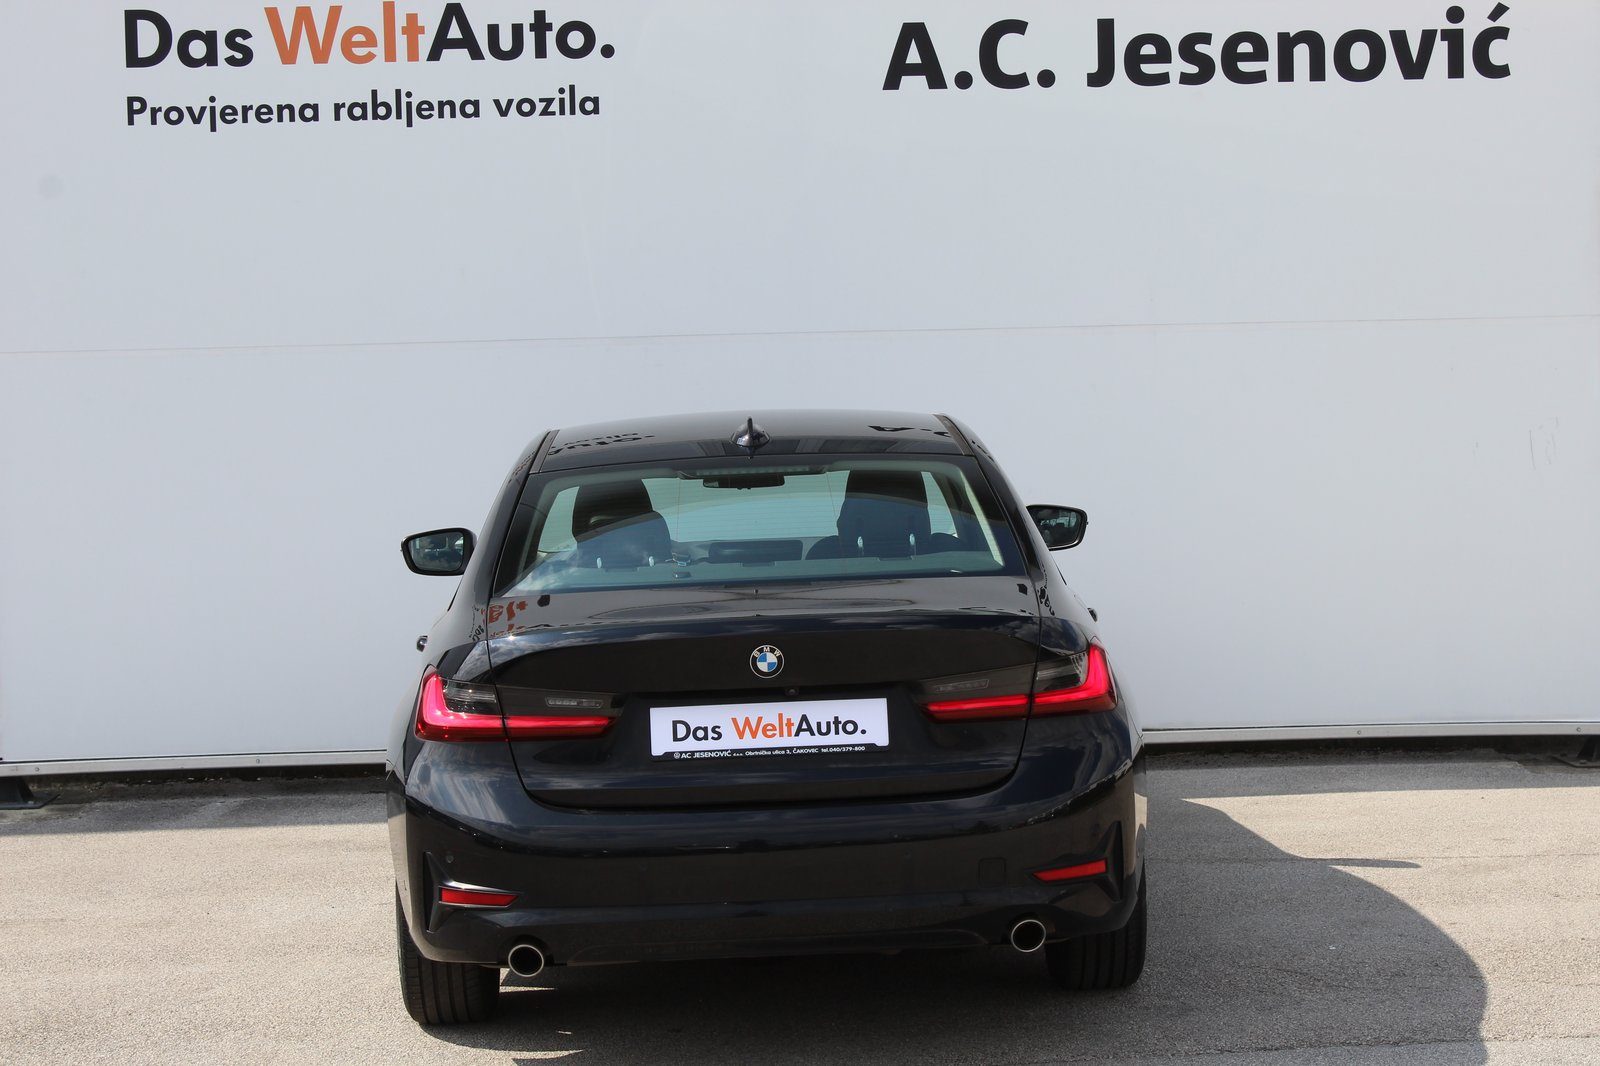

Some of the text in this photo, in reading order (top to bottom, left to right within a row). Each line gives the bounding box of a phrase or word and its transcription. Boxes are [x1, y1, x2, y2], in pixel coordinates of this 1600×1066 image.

[123, 0, 616, 69] Das WeltAuto.
[882, 1, 1512, 91] A.C. Jesenović
[126, 84, 600, 133] Provjerena rabljena vozila
[671, 712, 867, 743] Das WeltAuto.
